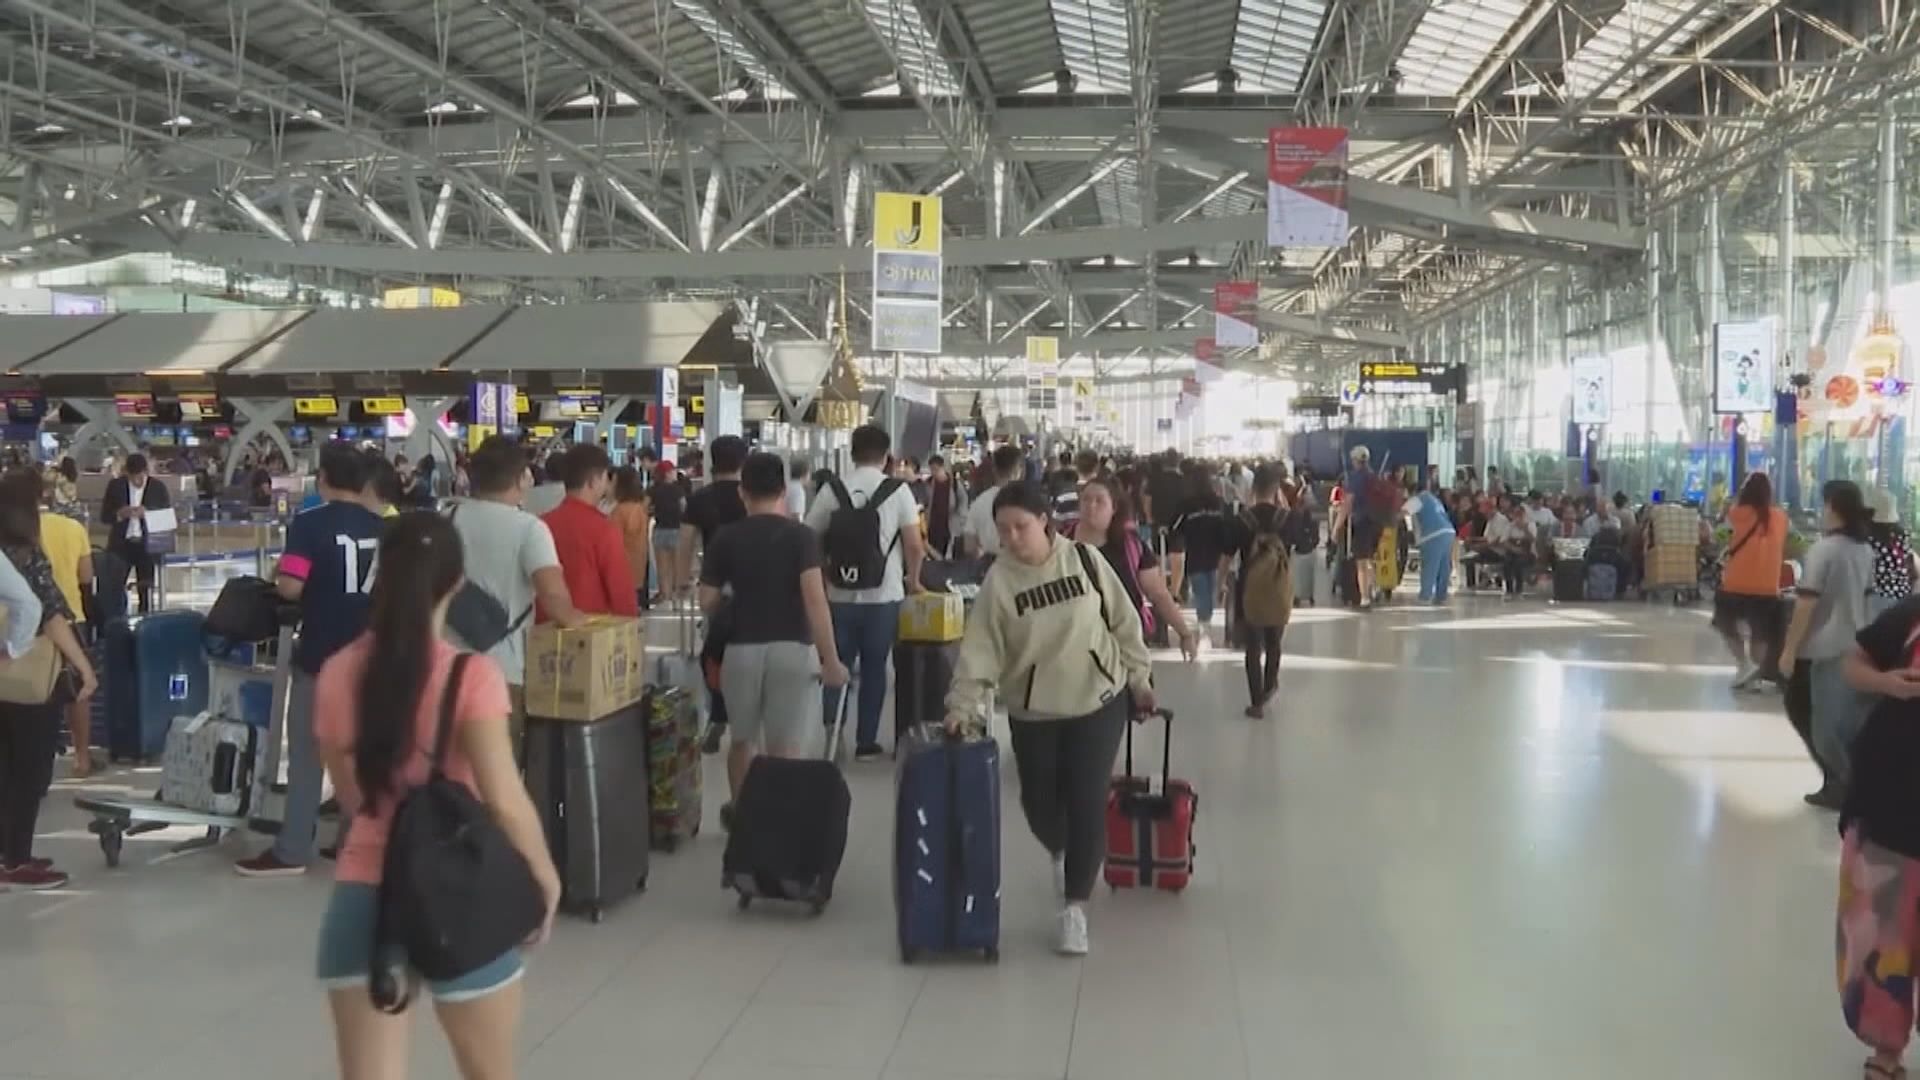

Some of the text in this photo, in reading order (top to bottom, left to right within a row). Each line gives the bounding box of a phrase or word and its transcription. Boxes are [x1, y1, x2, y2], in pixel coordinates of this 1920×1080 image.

[894, 201, 922, 245] J
[903, 266, 936, 281] THAI
[336, 534, 379, 593] 17
[1014, 575, 1085, 617] PUMA
